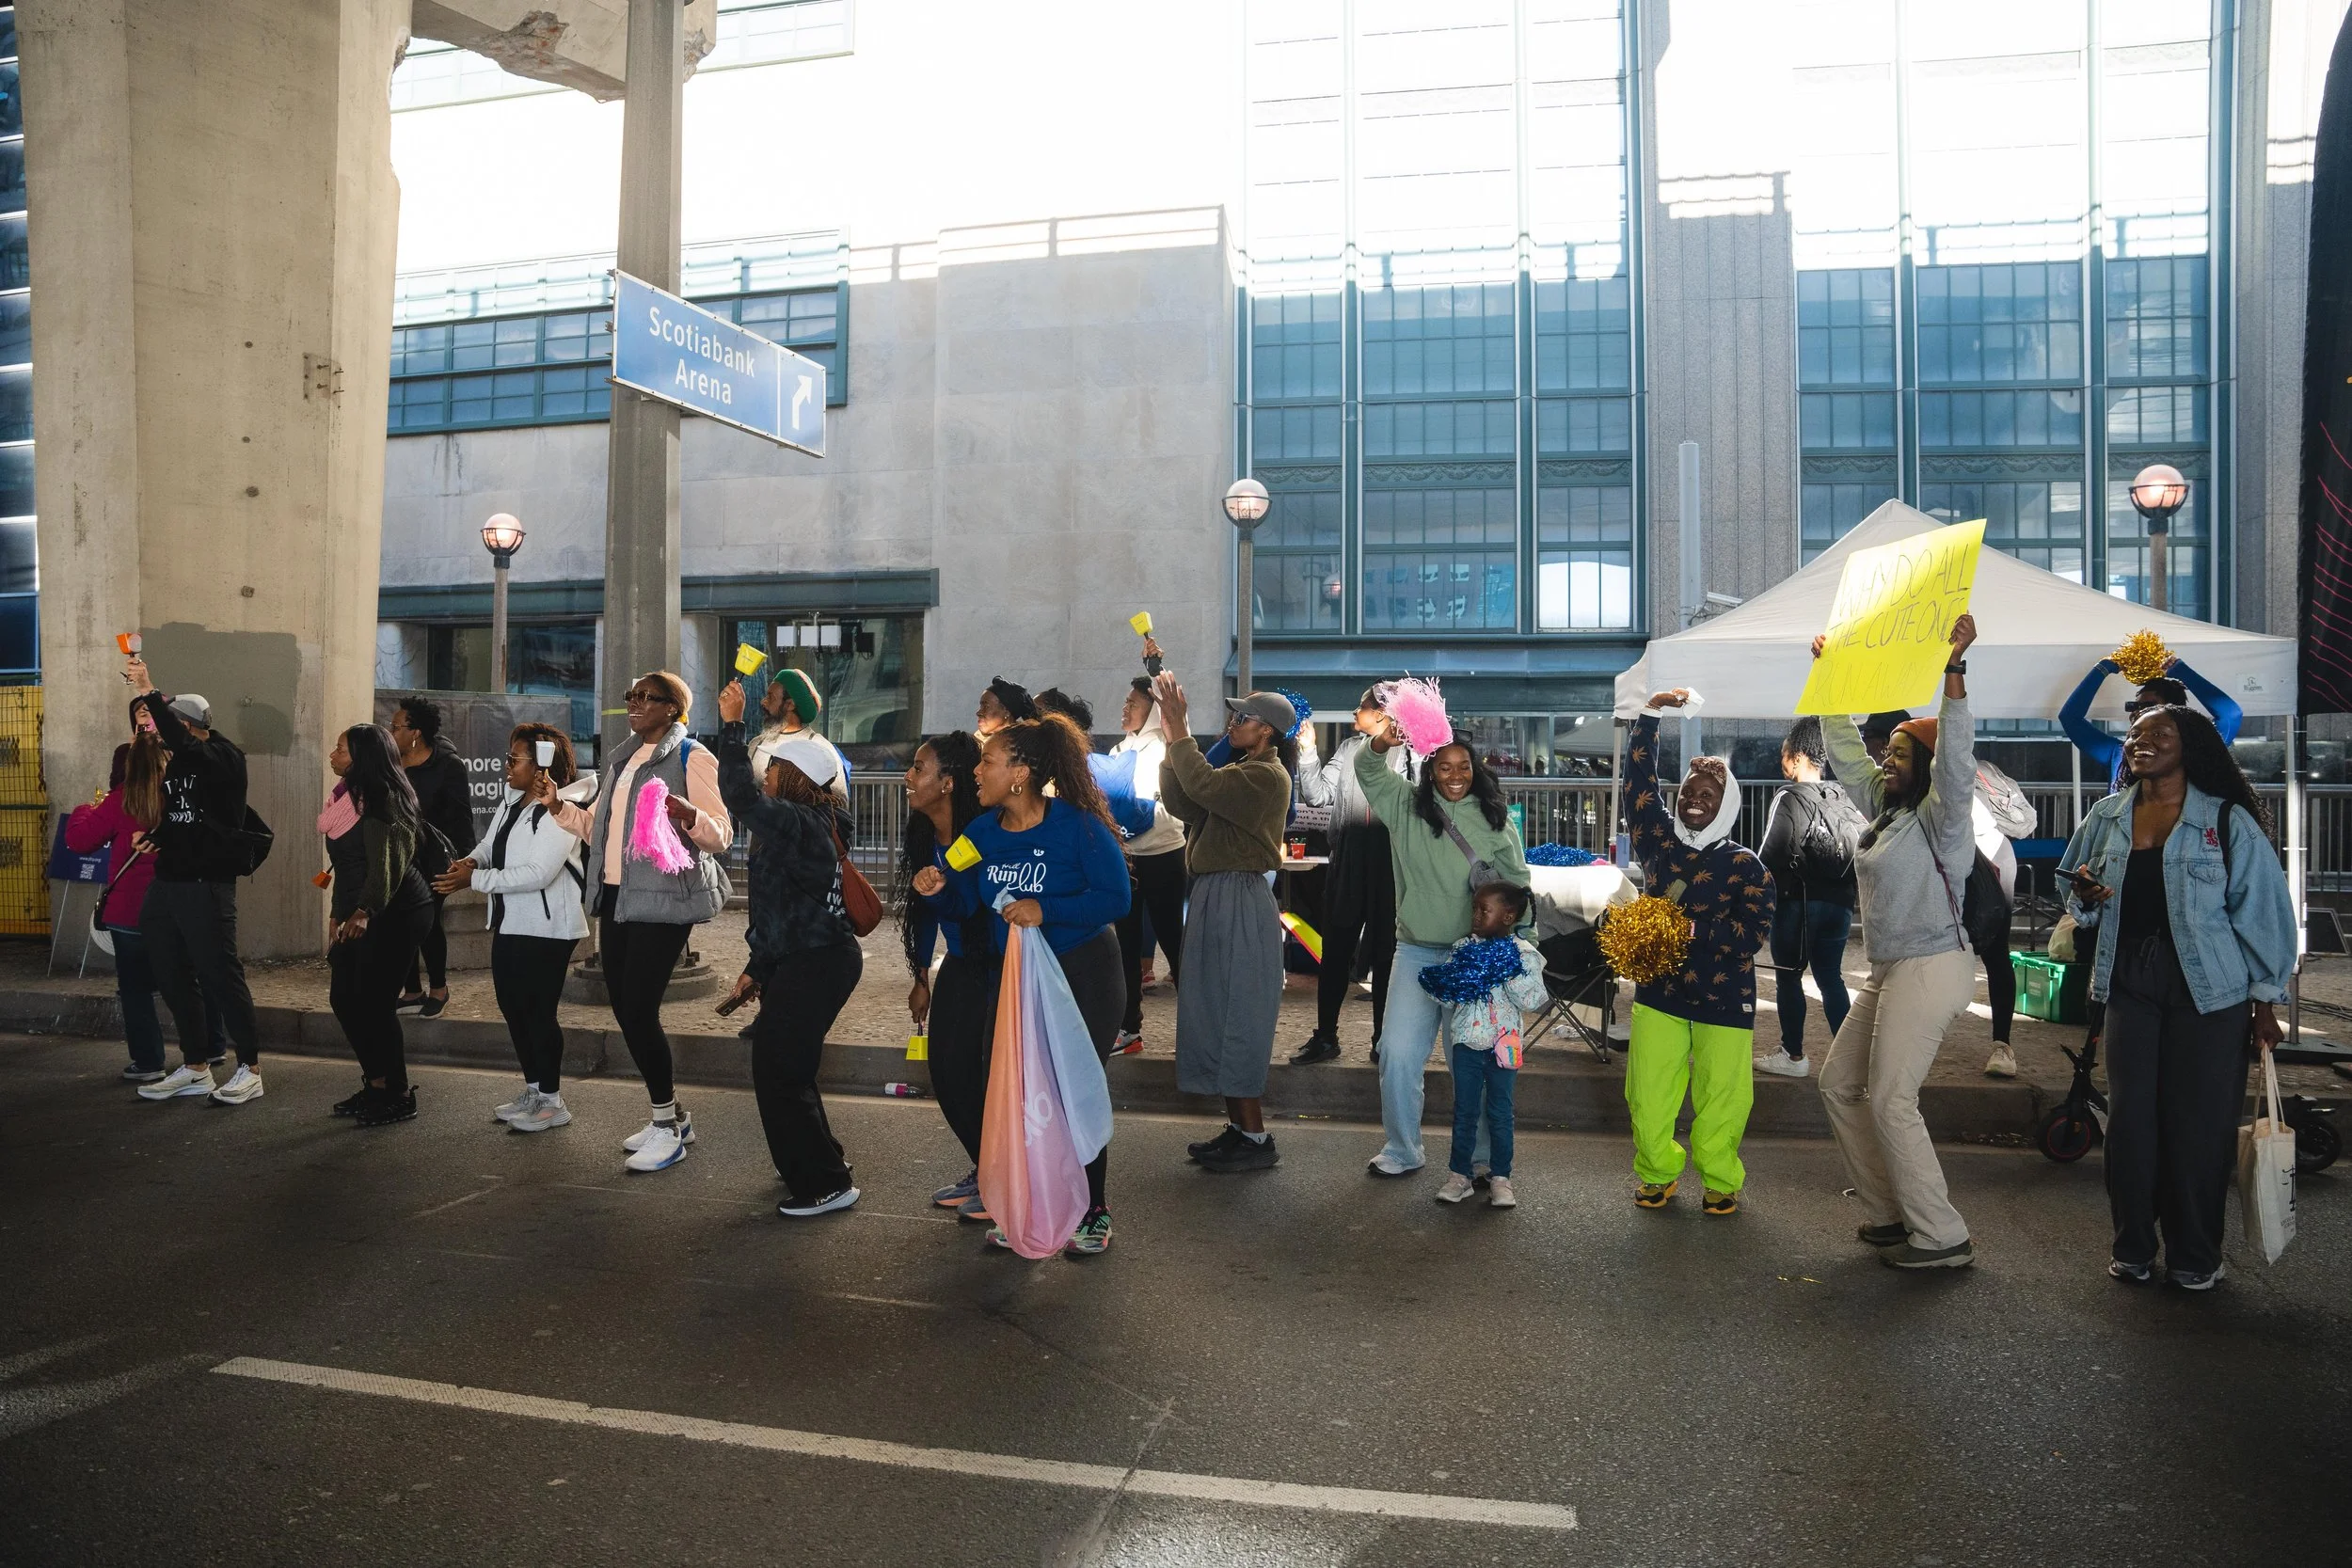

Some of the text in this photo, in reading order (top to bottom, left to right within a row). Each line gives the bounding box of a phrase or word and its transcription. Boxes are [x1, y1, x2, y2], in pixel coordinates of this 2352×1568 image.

[648, 307, 755, 378] Scotiabank
[675, 358, 732, 405] Arena
[1839, 543, 1971, 617] WHY DO ALL
[1828, 616, 1867, 654] THE
[1865, 602, 1920, 649] CUTE
[1812, 659, 1862, 707] RUN
[987, 865, 1018, 884] Run
